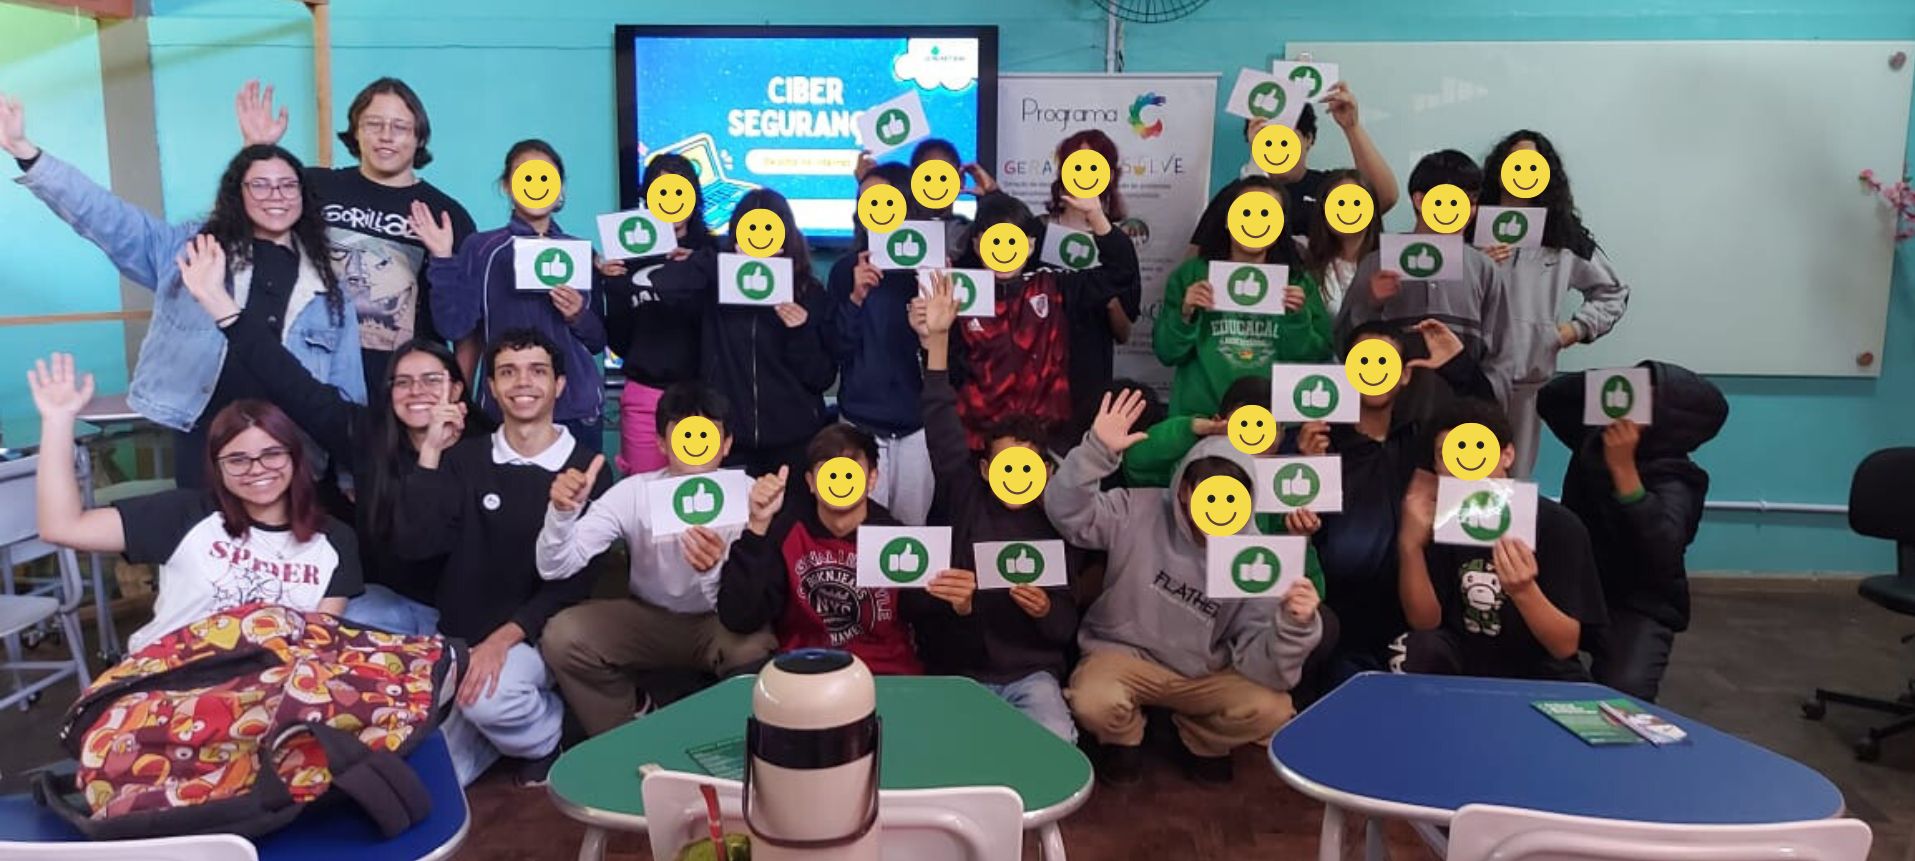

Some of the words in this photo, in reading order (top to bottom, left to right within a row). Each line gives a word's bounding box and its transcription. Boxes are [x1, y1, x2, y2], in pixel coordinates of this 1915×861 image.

[767, 76, 844, 104] CIBER
[728, 109, 865, 145] SEGURANÇ
[1021, 97, 1119, 131] Programa
[1153, 569, 1221, 619] FLATHE
